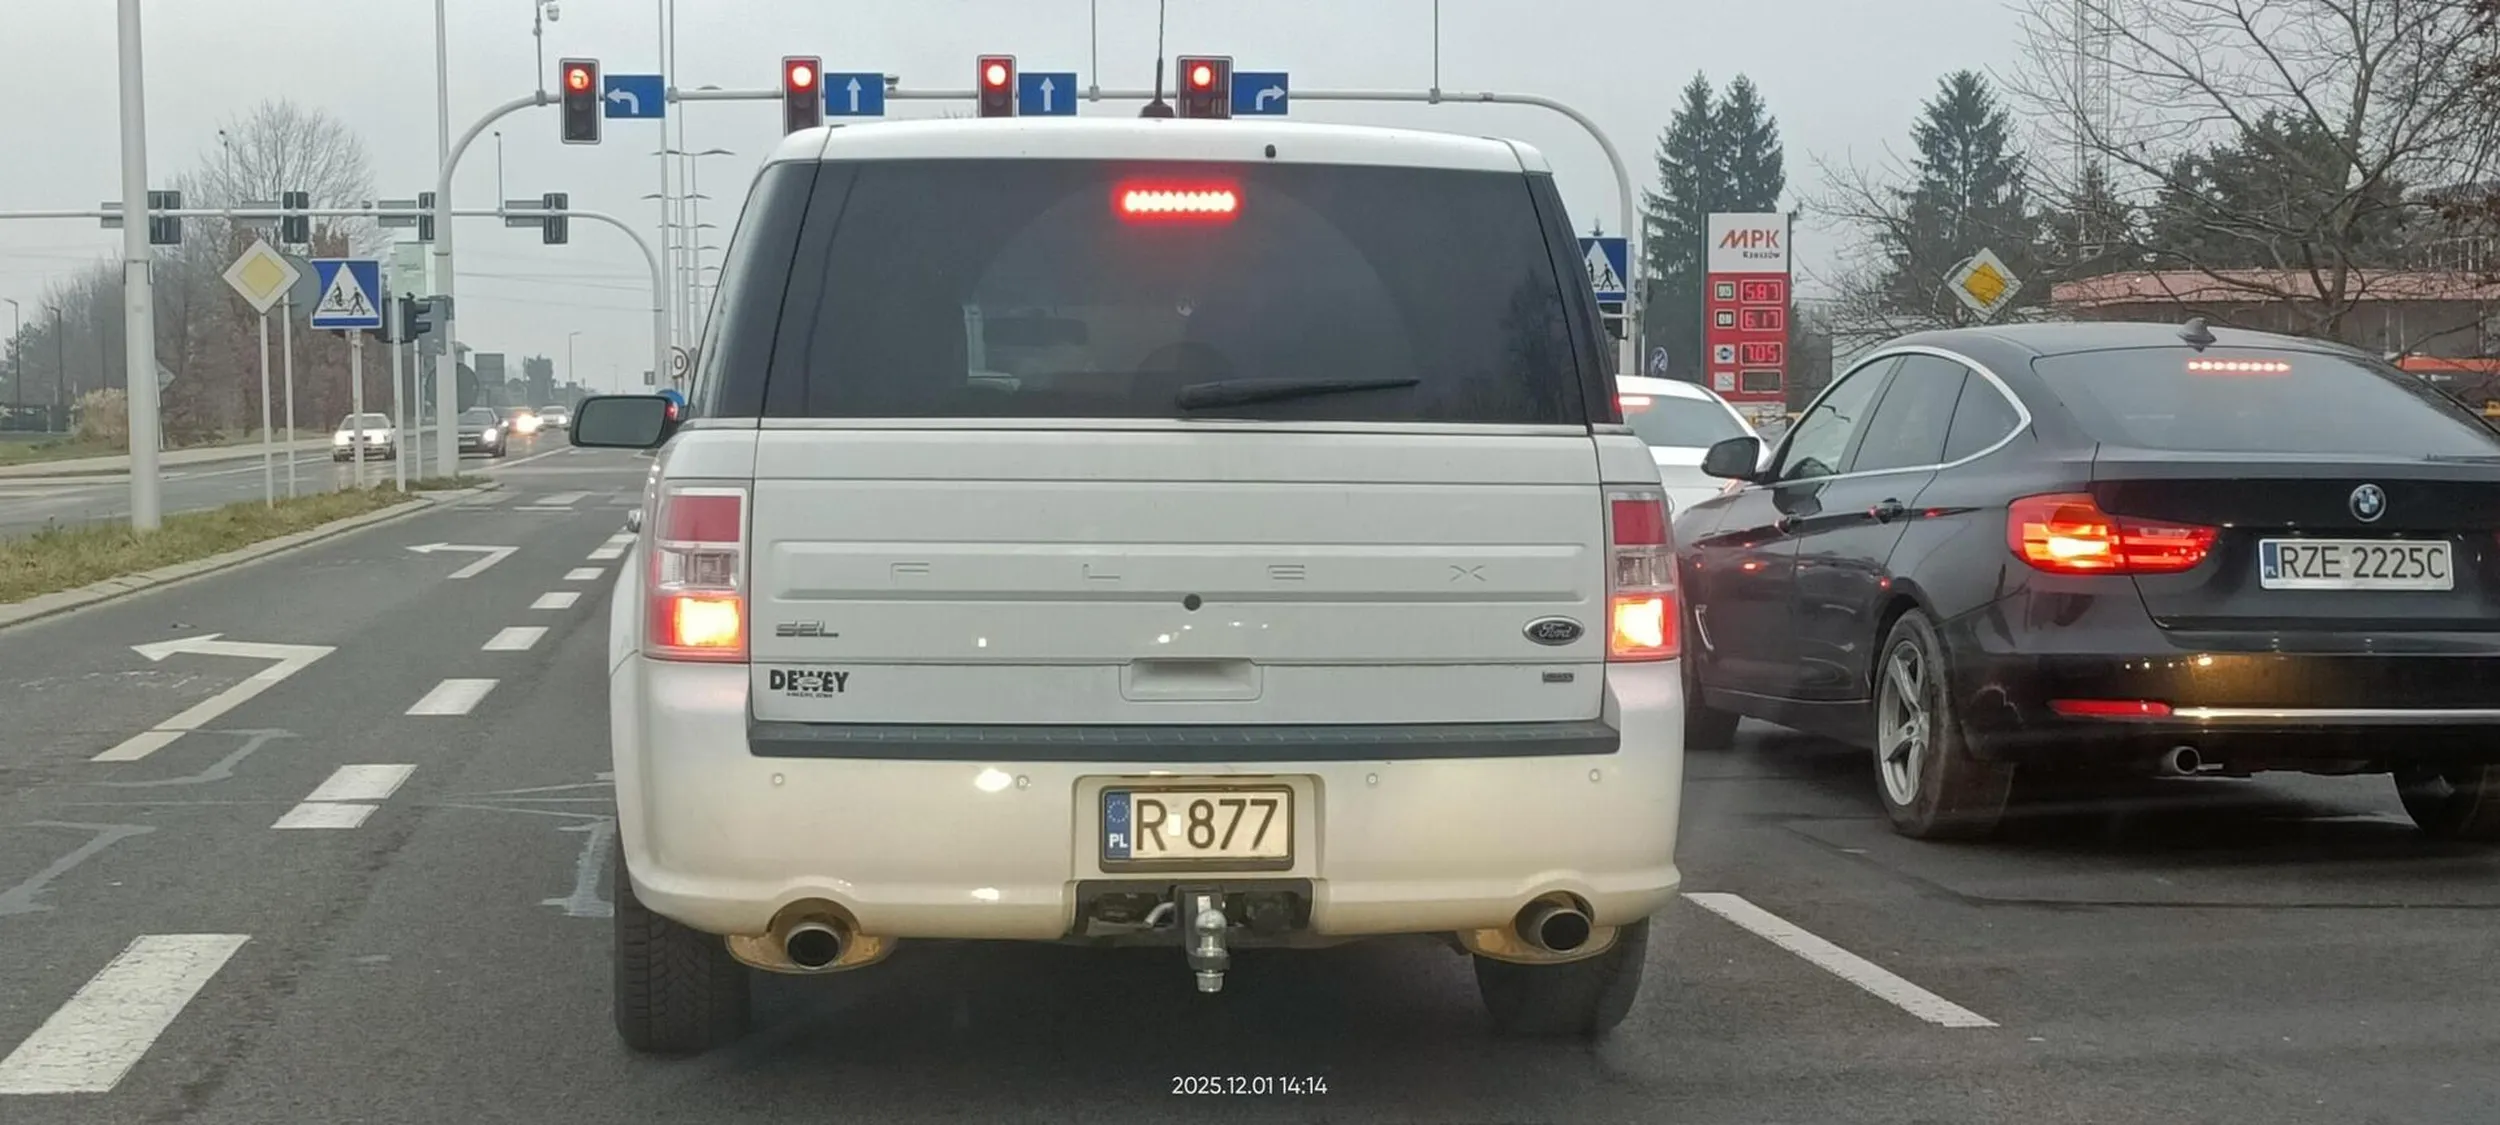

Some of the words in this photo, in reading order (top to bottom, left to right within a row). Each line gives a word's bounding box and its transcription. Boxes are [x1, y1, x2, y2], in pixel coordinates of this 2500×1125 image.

[1718, 229, 1780, 249] MPK
[2280, 546, 2341, 578] RZE
[2352, 547, 2445, 579] 2225C
[776, 620, 839, 637] SEL
[770, 669, 850, 692] DEWEY
[1108, 833, 1129, 849] PL
[1136, 799, 1167, 851] R
[1187, 799, 1278, 851] 877
